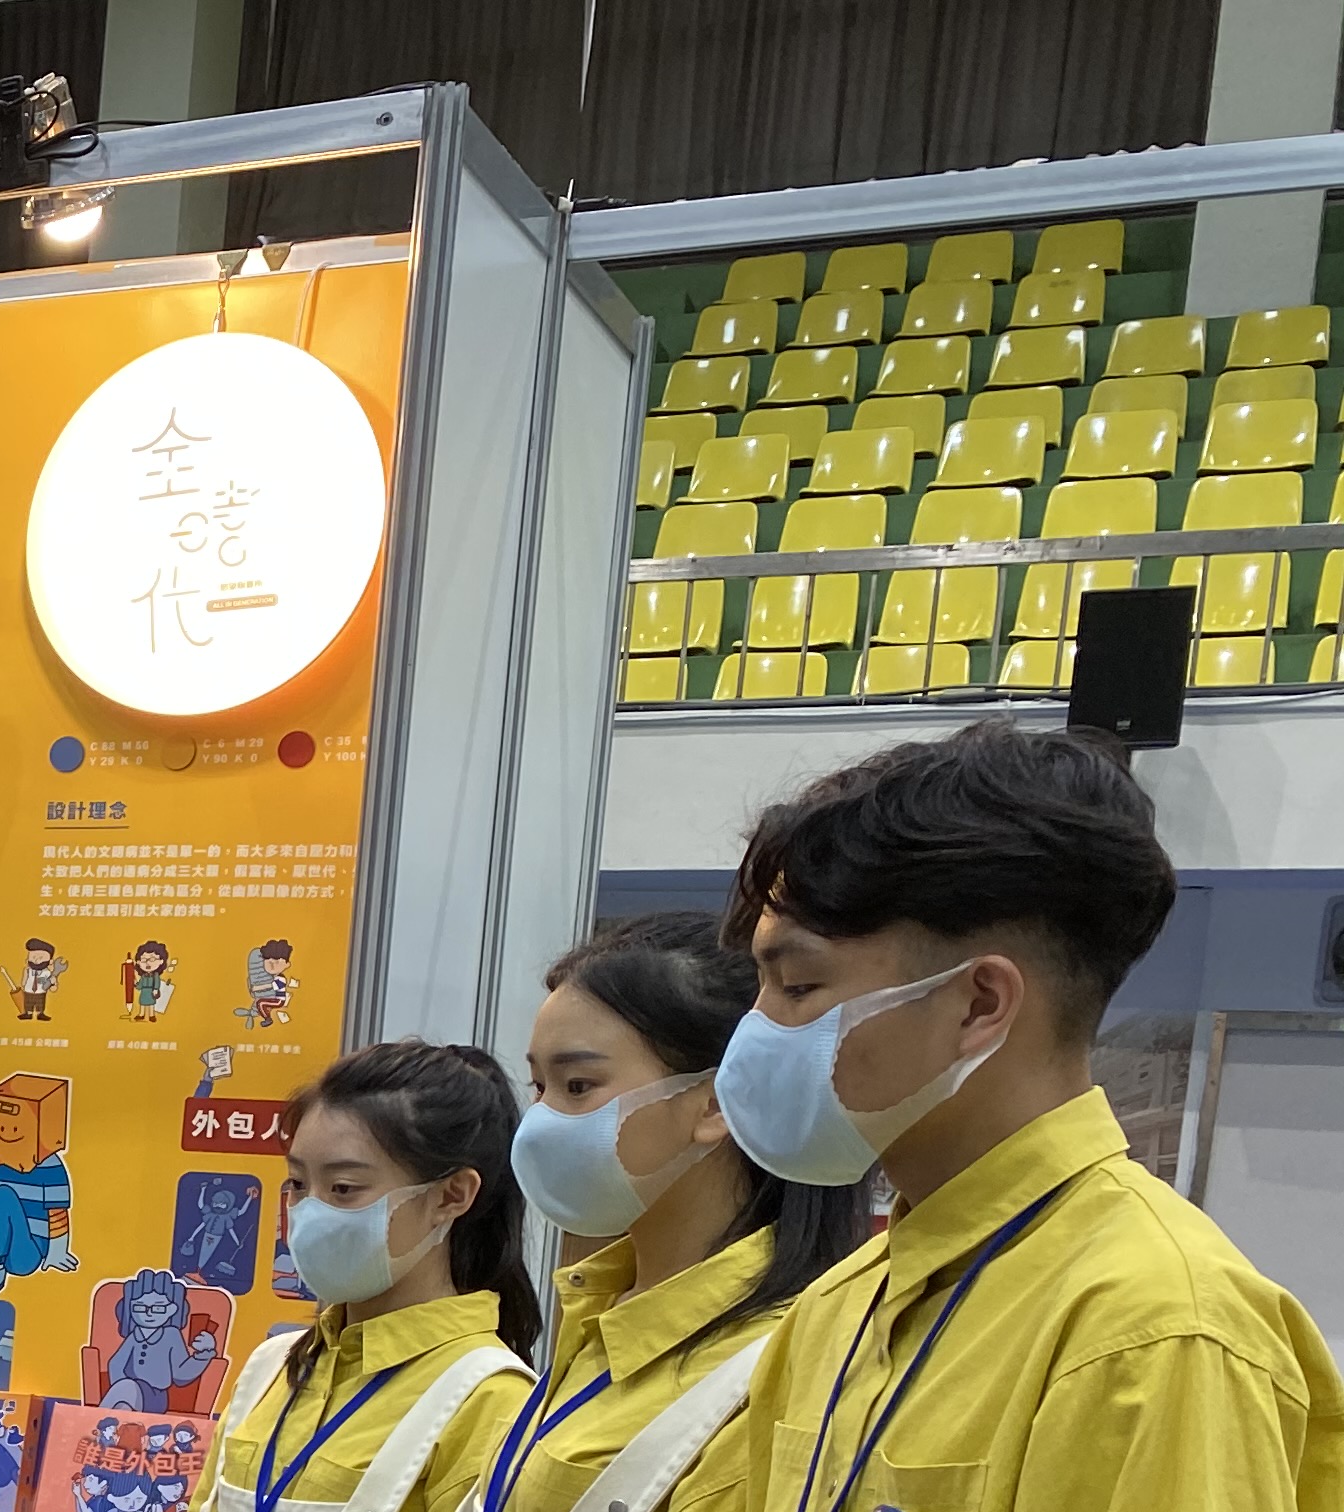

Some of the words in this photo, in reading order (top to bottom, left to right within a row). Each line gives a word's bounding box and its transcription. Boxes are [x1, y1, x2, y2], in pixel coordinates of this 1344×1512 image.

[47, 801, 127, 820] 設計理念
[73, 1442, 205, 1477] 誰是外包王
